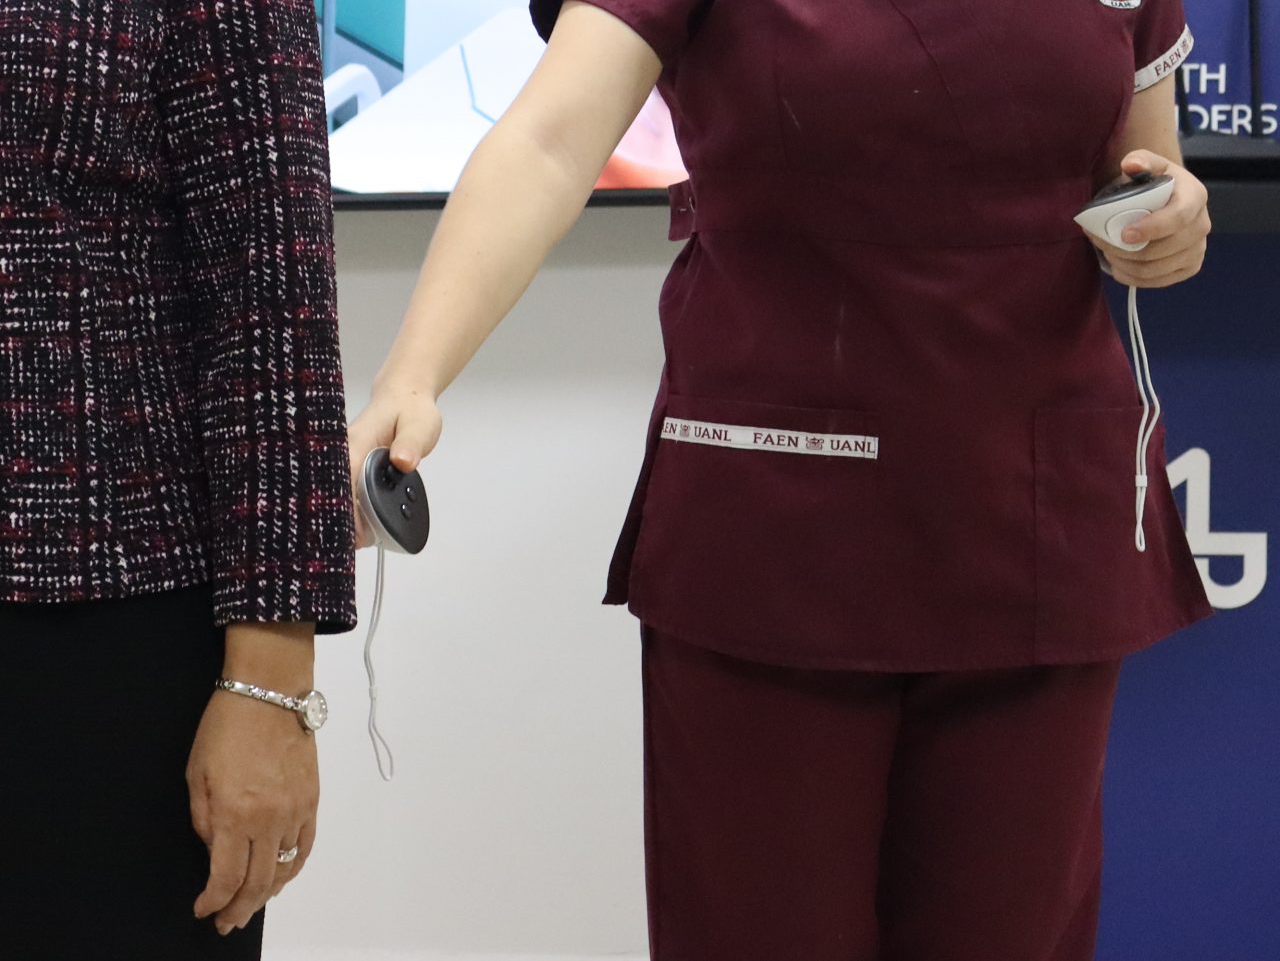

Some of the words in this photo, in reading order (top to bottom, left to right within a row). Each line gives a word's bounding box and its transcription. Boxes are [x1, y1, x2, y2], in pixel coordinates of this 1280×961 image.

[1155, 49, 1182, 76] FAEN
[694, 425, 732, 442] UANL
[753, 432, 799, 447] FAEN
[830, 439, 876, 454] UANL
